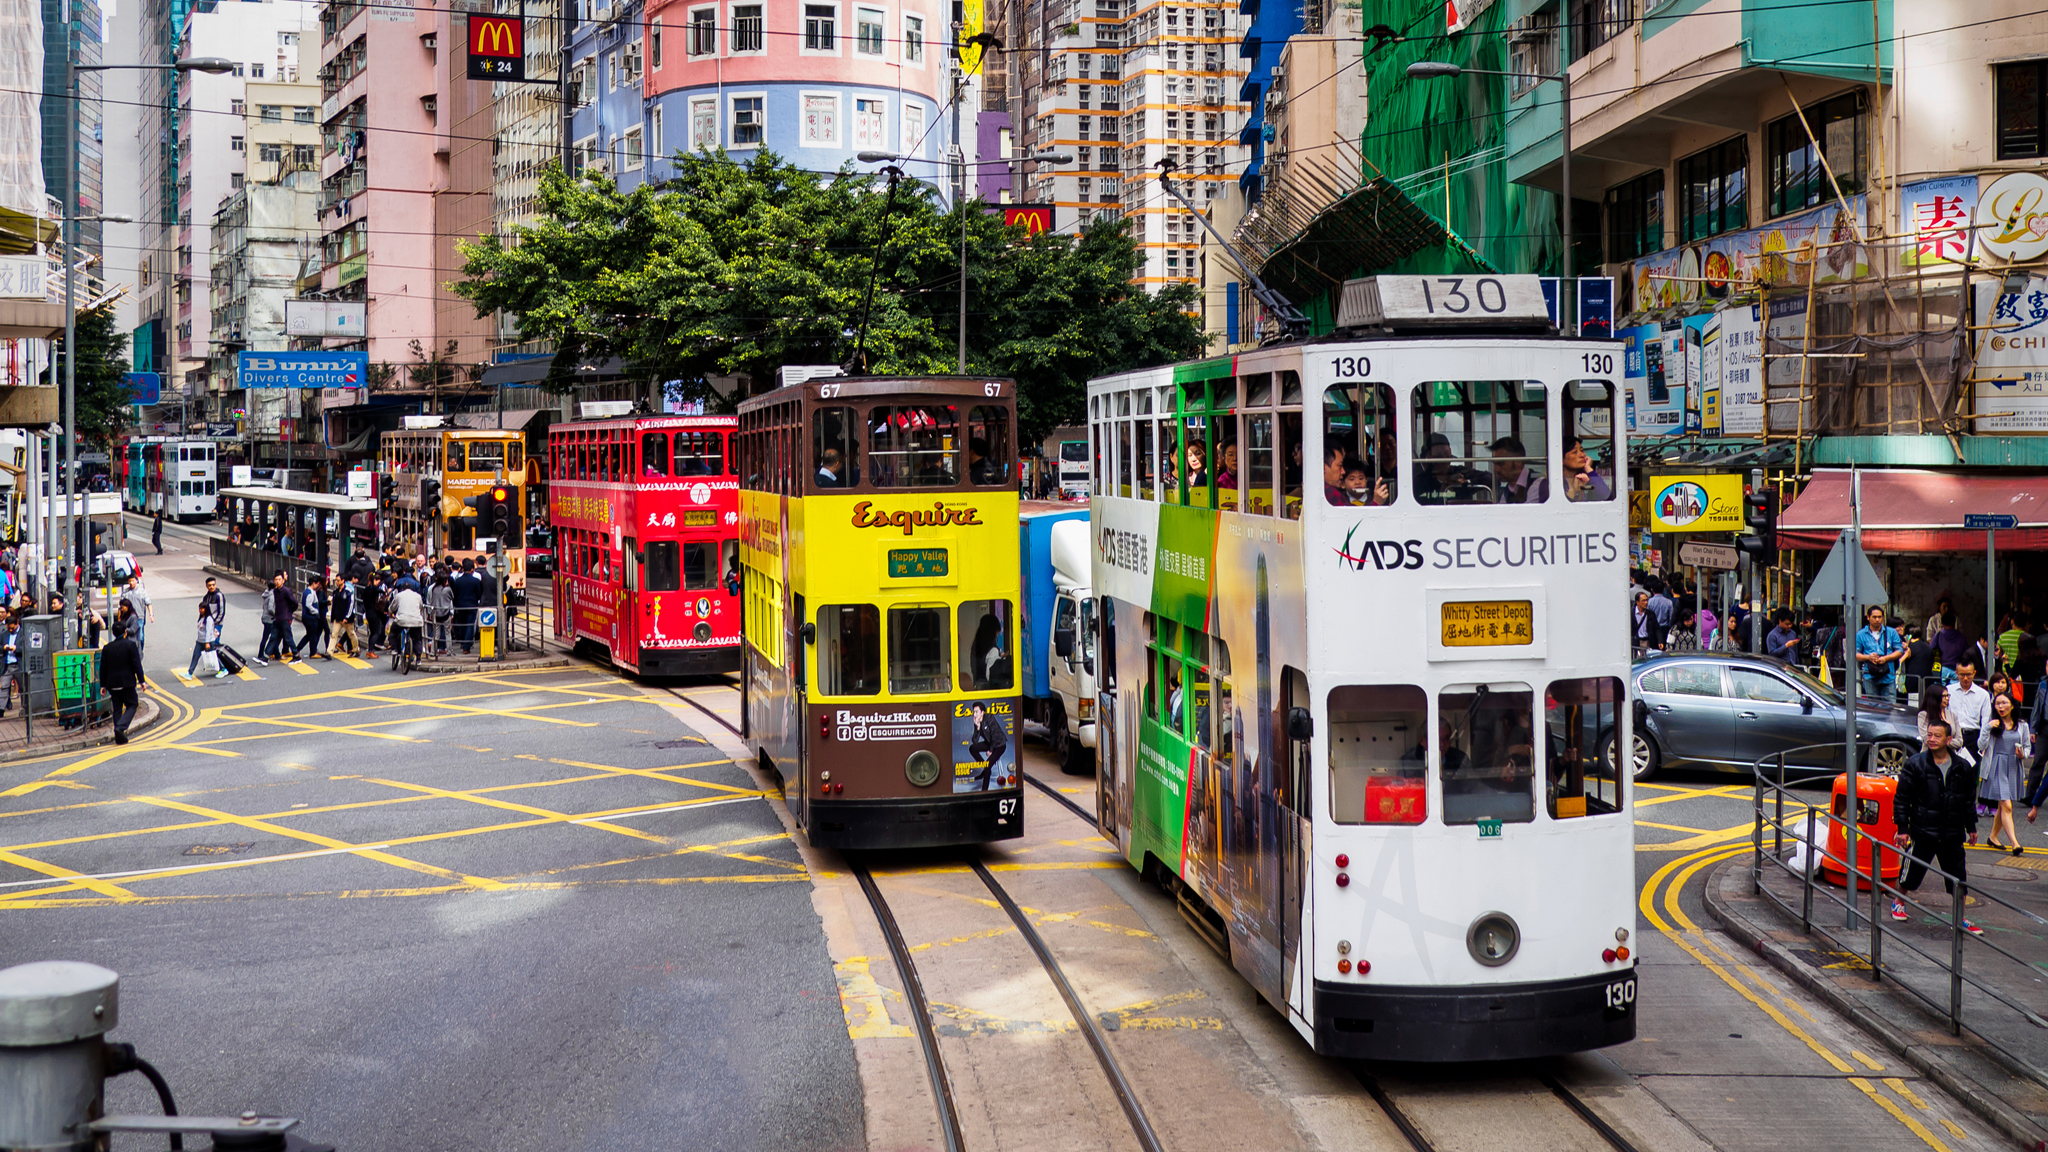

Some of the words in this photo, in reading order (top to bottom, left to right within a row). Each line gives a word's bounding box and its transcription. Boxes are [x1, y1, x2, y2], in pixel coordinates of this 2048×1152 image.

[497, 61, 513, 73] 24
[1906, 184, 1927, 193] Vegan
[1928, 181, 1954, 190] Cuisine
[1960, 178, 1973, 187] 2/F
[1912, 195, 1967, 259] 素
[1750, 227, 1782, 250] Loing
[1785, 221, 1802, 241] Hut
[1421, 278, 1507, 314] 130
[1995, 290, 2048, 321] 致富
[1331, 357, 1371, 377] 130
[1581, 353, 1613, 375] 130
[244, 373, 289, 383] Divers
[298, 373, 345, 383] Centre
[820, 383, 841, 399] 67
[984, 382, 1002, 397] 67
[2023, 383, 2042, 392] 入口
[1709, 497, 1739, 516] Store
[646, 512, 676, 528] 天廚
[851, 501, 983, 536] Esquire
[891, 551, 919, 563] Happy
[921, 550, 948, 563] Valley
[1356, 539, 1424, 571] ADS
[1432, 532, 1617, 570] SECURITIES
[1714, 548, 1726, 556] Road
[897, 563, 943, 574] 跑馬地
[1443, 605, 1471, 622] Whitty
[1474, 605, 1500, 620] Street
[1503, 604, 1529, 621] Depot
[1444, 622, 1529, 639] 屈地街電車廠
[836, 710, 937, 727] EsquireHK.com
[872, 728, 934, 737] ESQUIREHK.COM
[955, 761, 990, 770] ANNIVERSARY
[955, 768, 971, 776] ISSUE
[998, 798, 1017, 815] 67
[1480, 824, 1501, 836] 006
[1605, 979, 1635, 1007] 130
